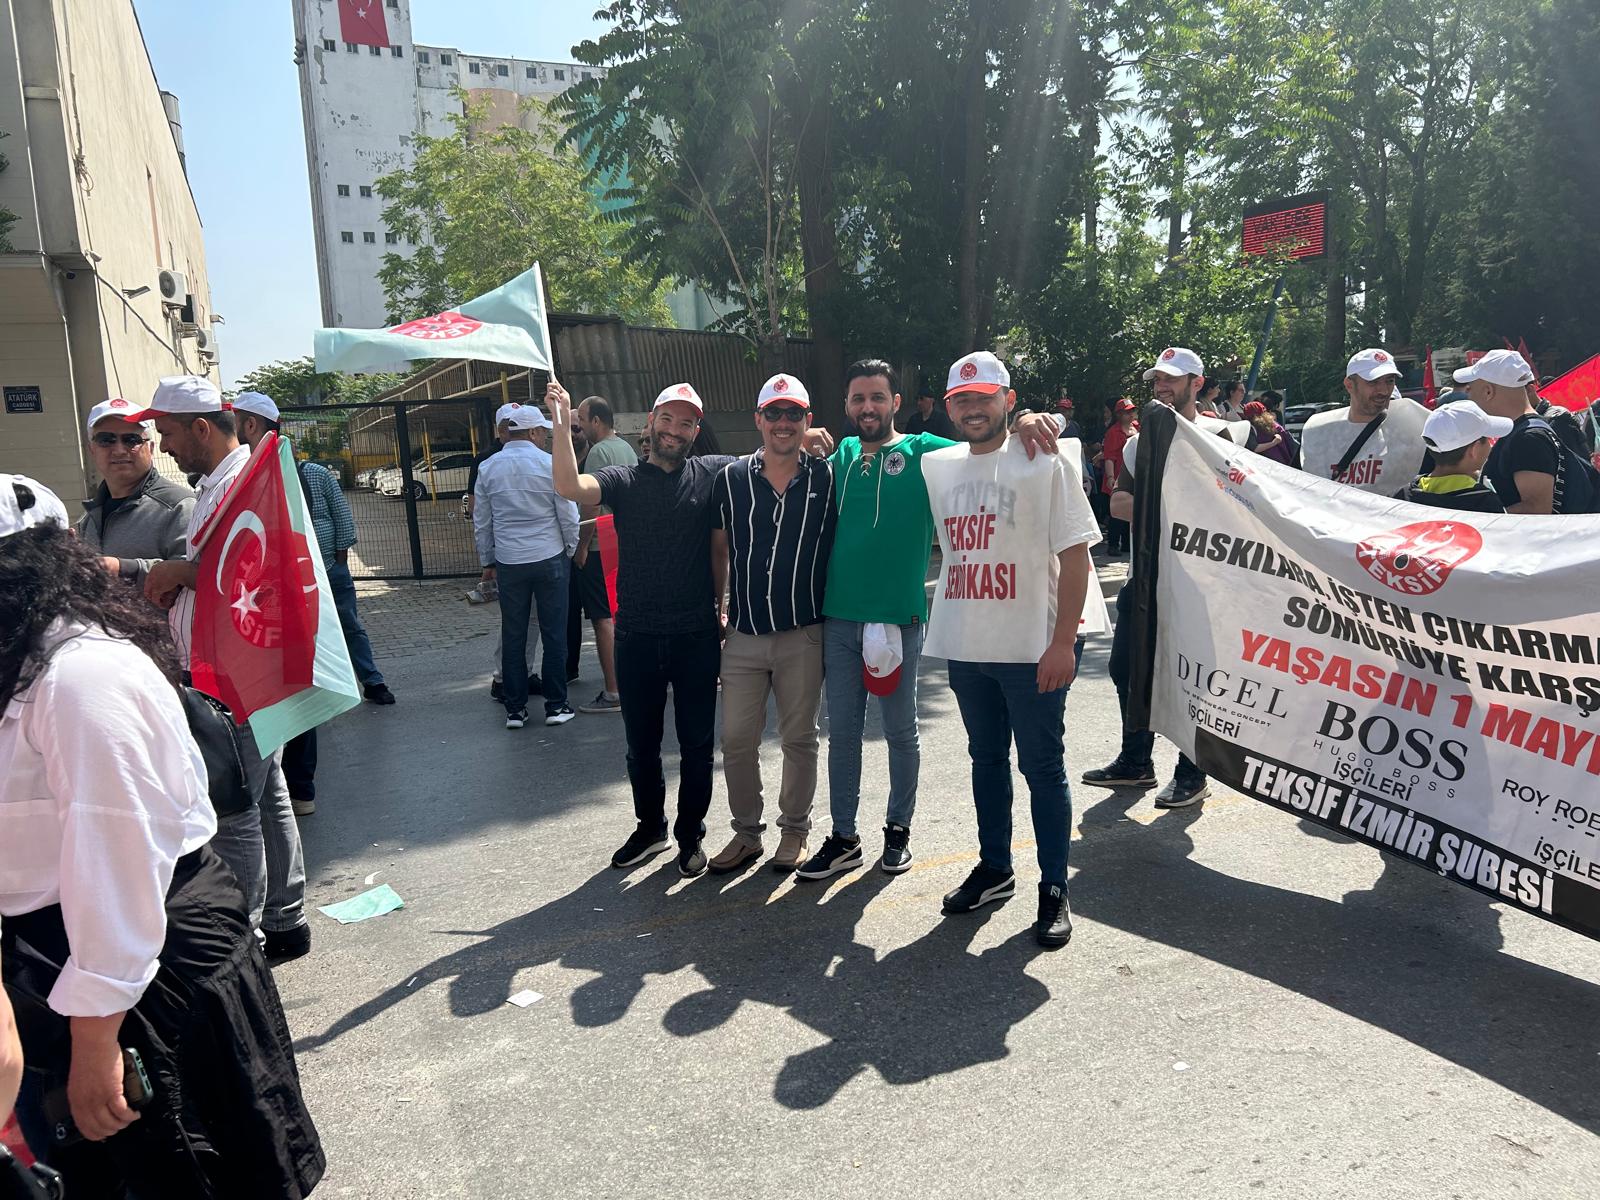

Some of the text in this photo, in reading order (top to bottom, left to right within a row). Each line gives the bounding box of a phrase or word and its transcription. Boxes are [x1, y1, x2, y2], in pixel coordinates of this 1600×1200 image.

[944, 505, 996, 551] TEKSİF
[944, 555, 1016, 600] SENDİKASI
[1170, 522, 1600, 665] BASKILARA, İŞTEN ÇIKARM
[1283, 596, 1471, 684] SÖMÜRÜYE
[1177, 652, 1288, 719] DIGEL
[1240, 629, 1438, 718] YAŞASIN
[1450, 694, 1473, 729] 1
[1188, 699, 1242, 738] İŞÇİLERİ
[1231, 710, 1271, 727] CONCEPT
[1316, 699, 1468, 781] BOSS
[1313, 739, 1456, 799] HUGO BOSS
[1333, 757, 1414, 801] İŞÇİLERİ
[1501, 778, 1551, 807] ROY
[1241, 755, 1554, 915] TEKSİF İZMİR ŞUBESİ
